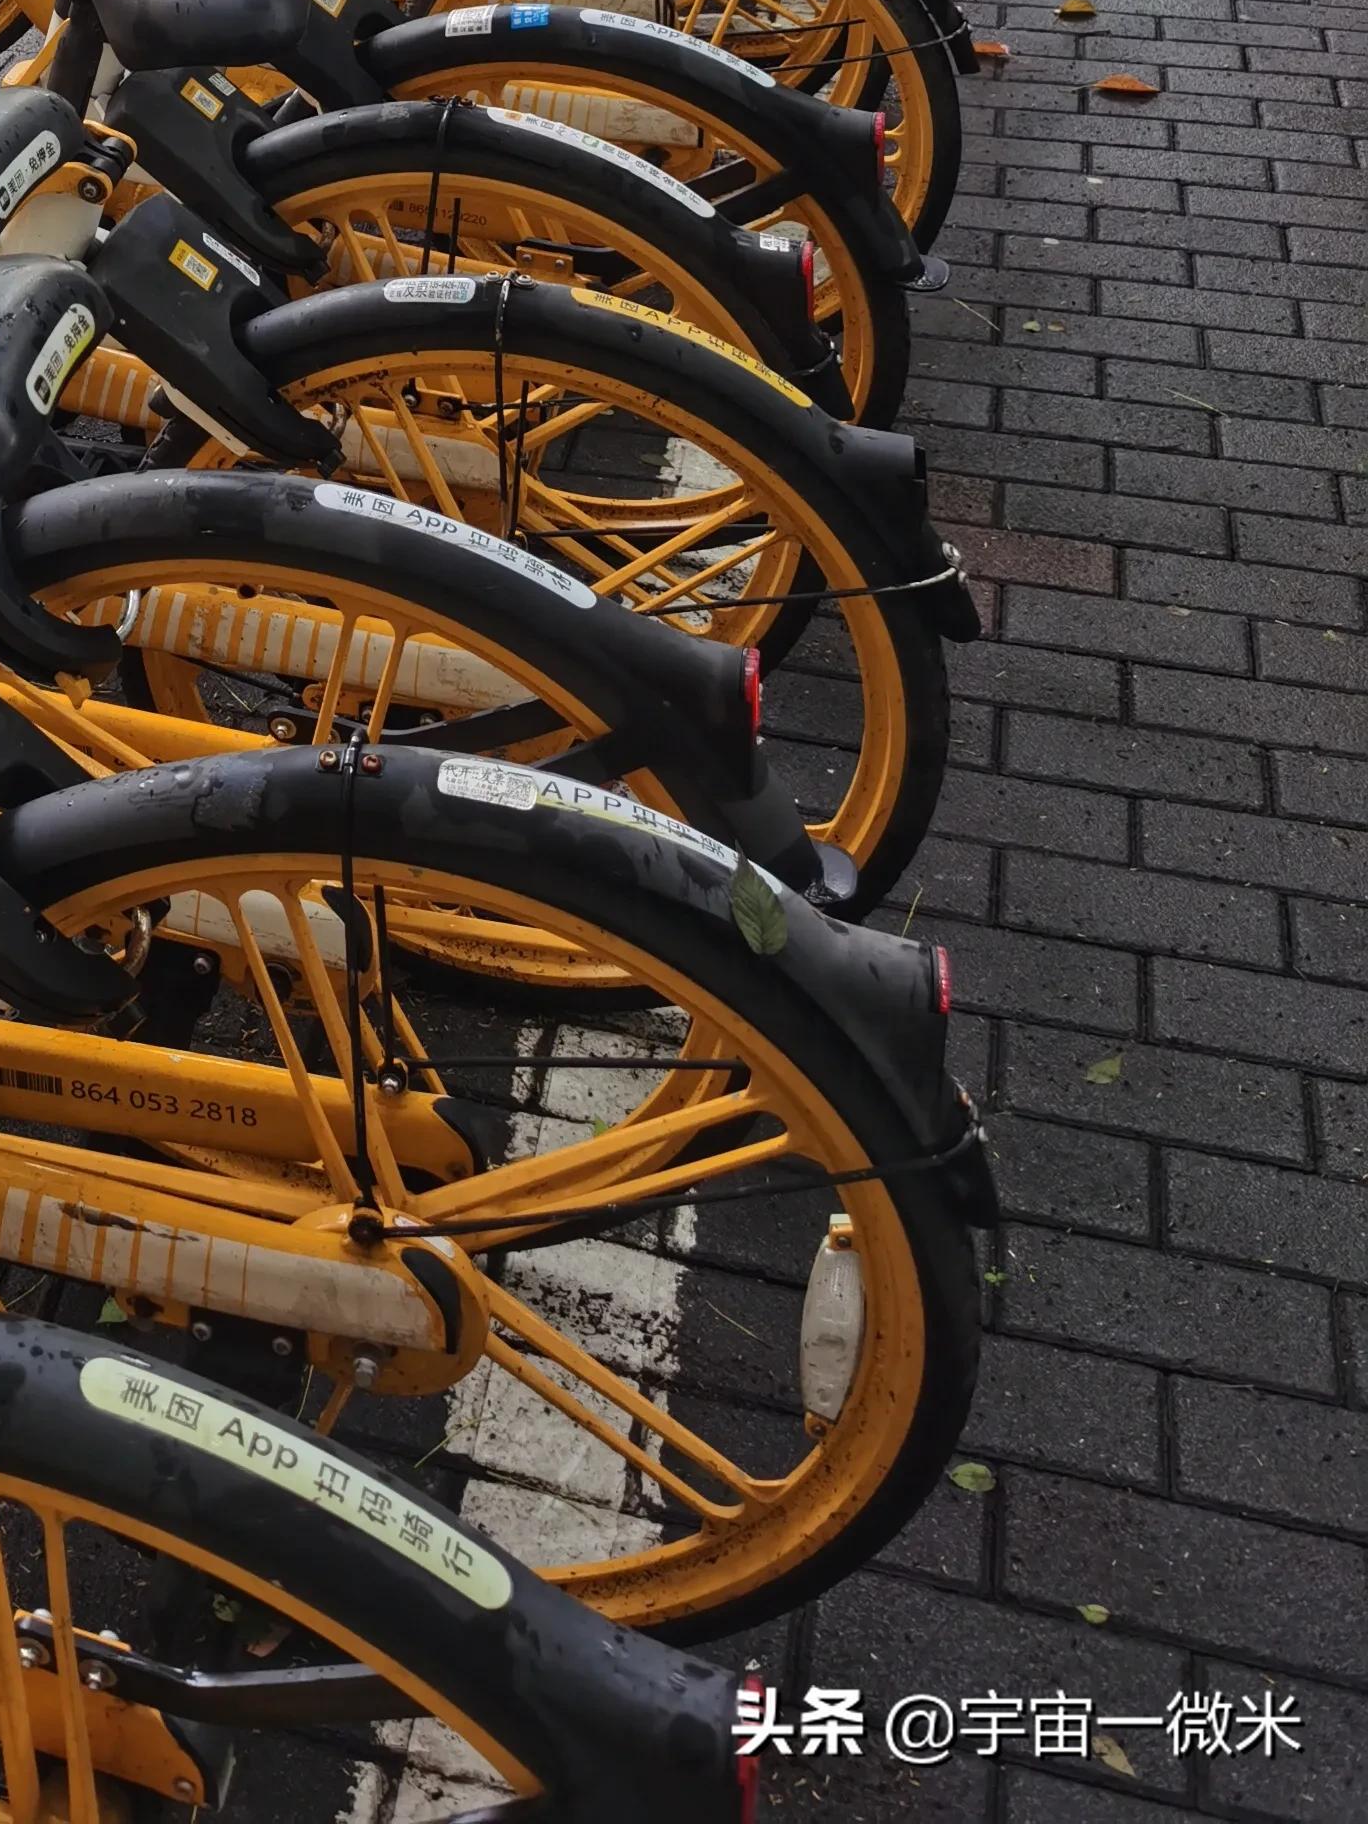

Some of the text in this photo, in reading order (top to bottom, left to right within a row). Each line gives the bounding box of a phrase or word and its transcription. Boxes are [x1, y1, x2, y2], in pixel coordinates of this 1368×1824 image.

[70, 1079, 258, 1127] 864 053 2818
